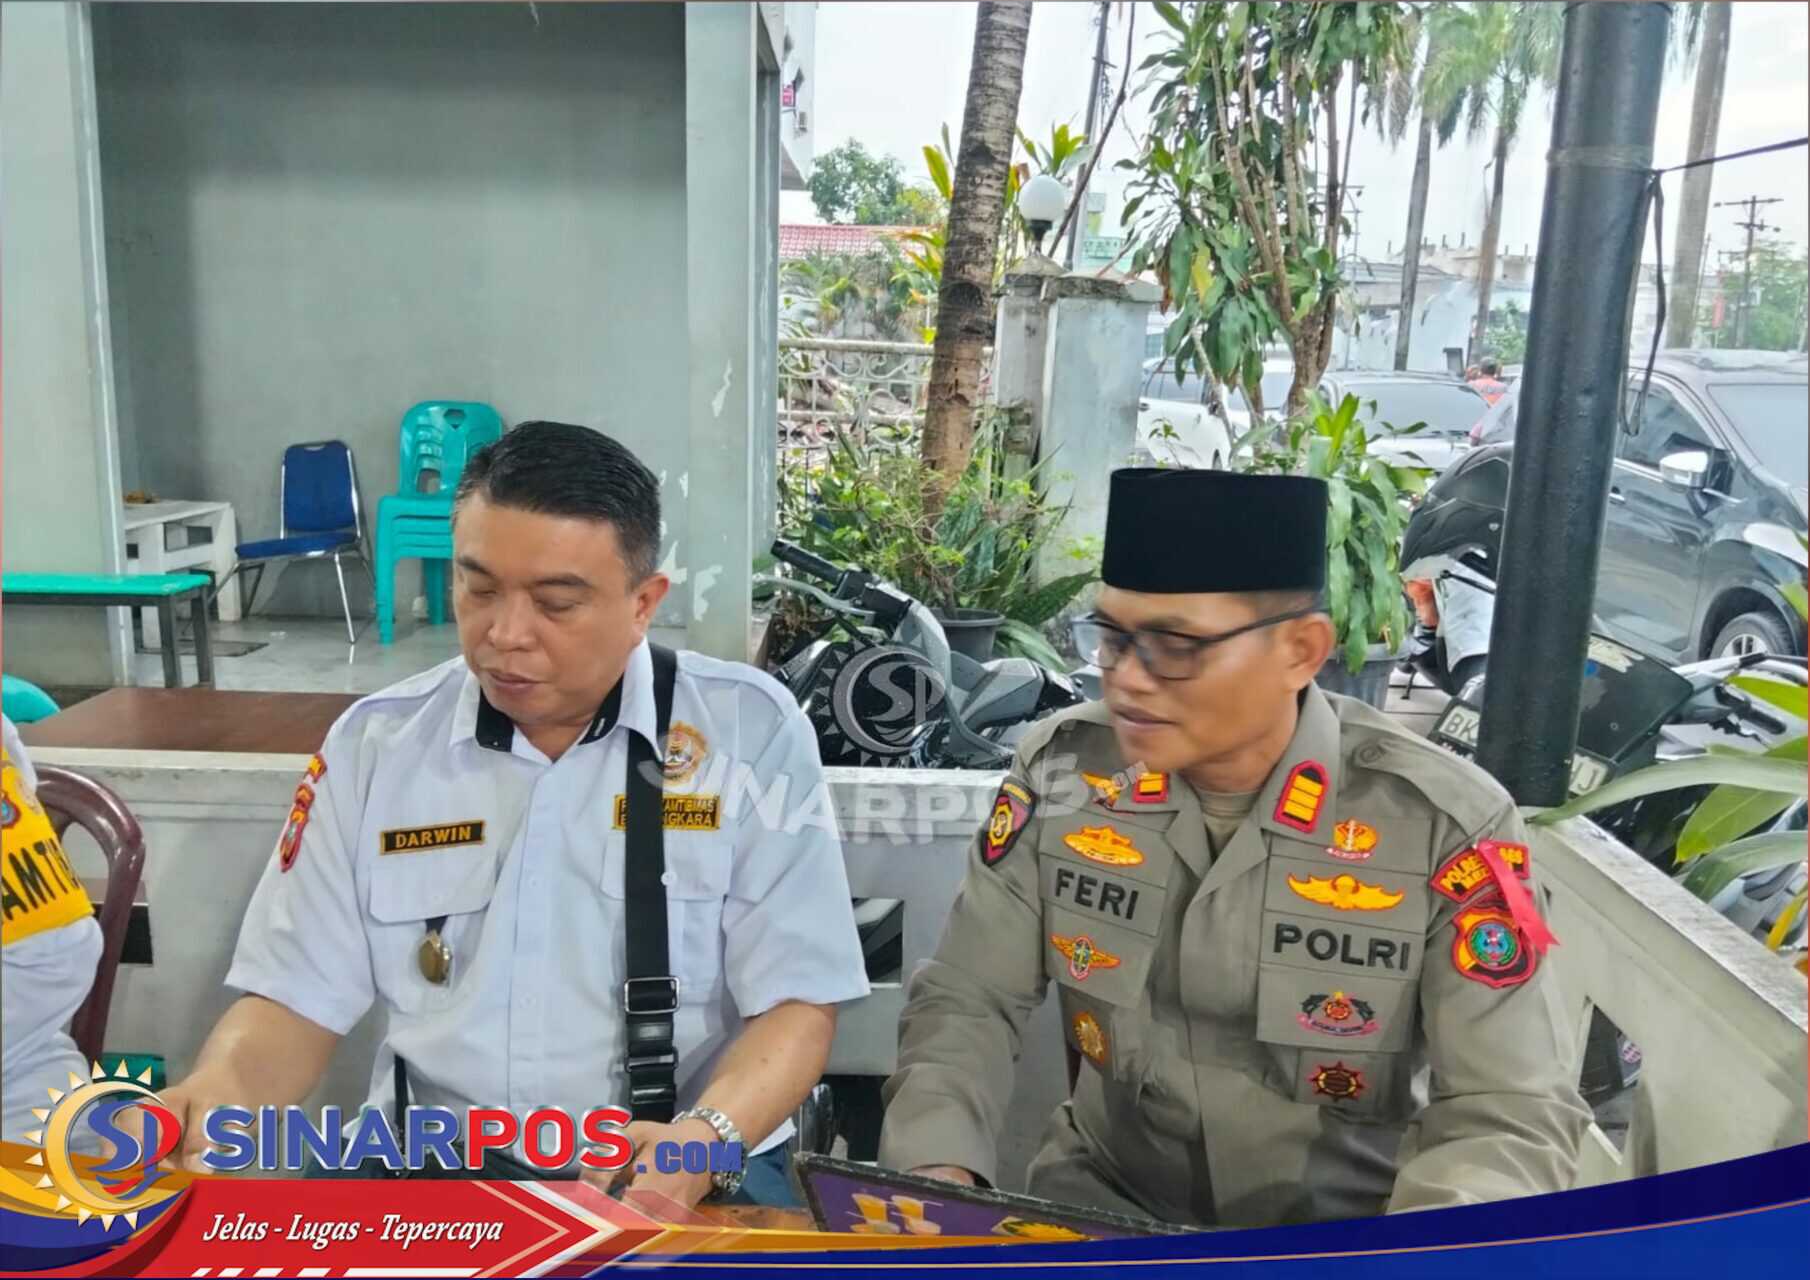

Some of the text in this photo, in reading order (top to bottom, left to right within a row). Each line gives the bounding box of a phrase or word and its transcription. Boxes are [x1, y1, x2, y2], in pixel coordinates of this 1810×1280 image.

[395, 825, 472, 848] DARWIN
[1054, 868, 1140, 920] FERI
[1272, 922, 1412, 971] POLRI
